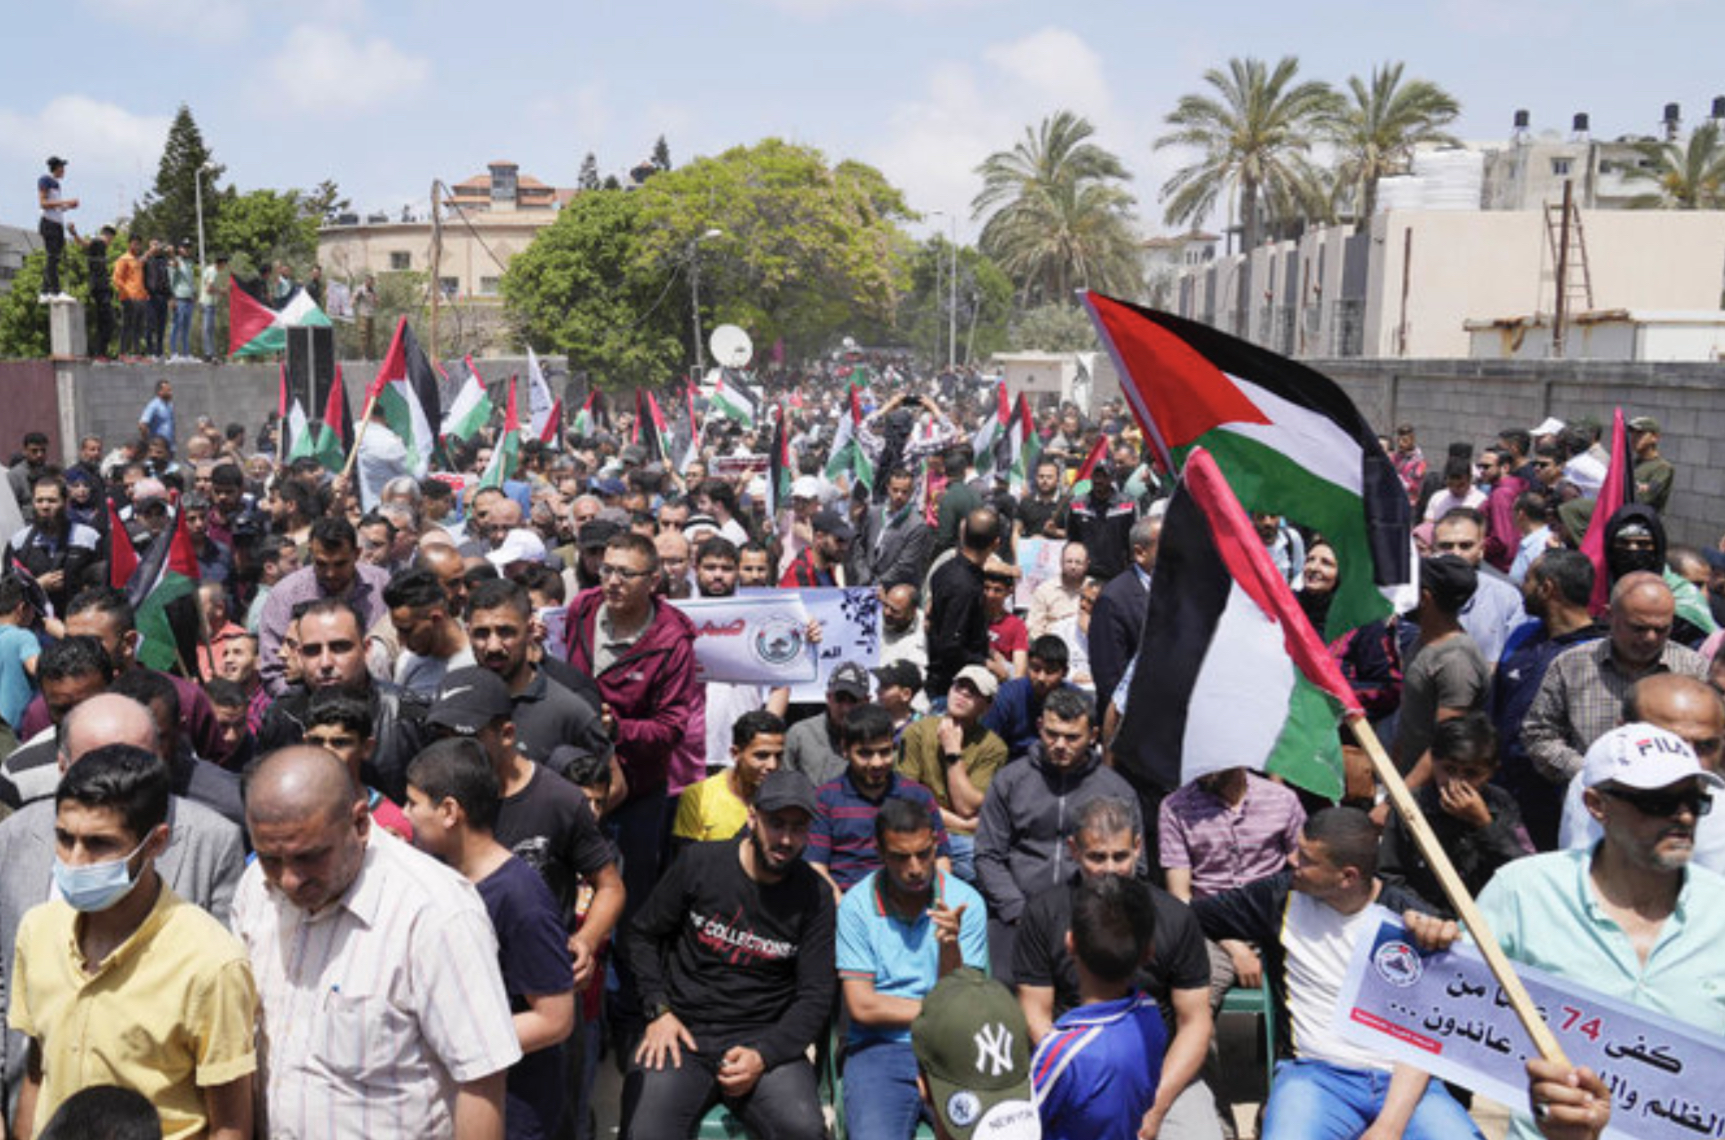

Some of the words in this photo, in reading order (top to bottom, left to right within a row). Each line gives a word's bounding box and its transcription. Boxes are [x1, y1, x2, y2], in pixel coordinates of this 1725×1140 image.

[1446, 972, 1486, 998] من
[1561, 1005, 1602, 1041] 74
[973, 1022, 1014, 1077] NY
[1604, 1035, 1682, 1074] كفى
